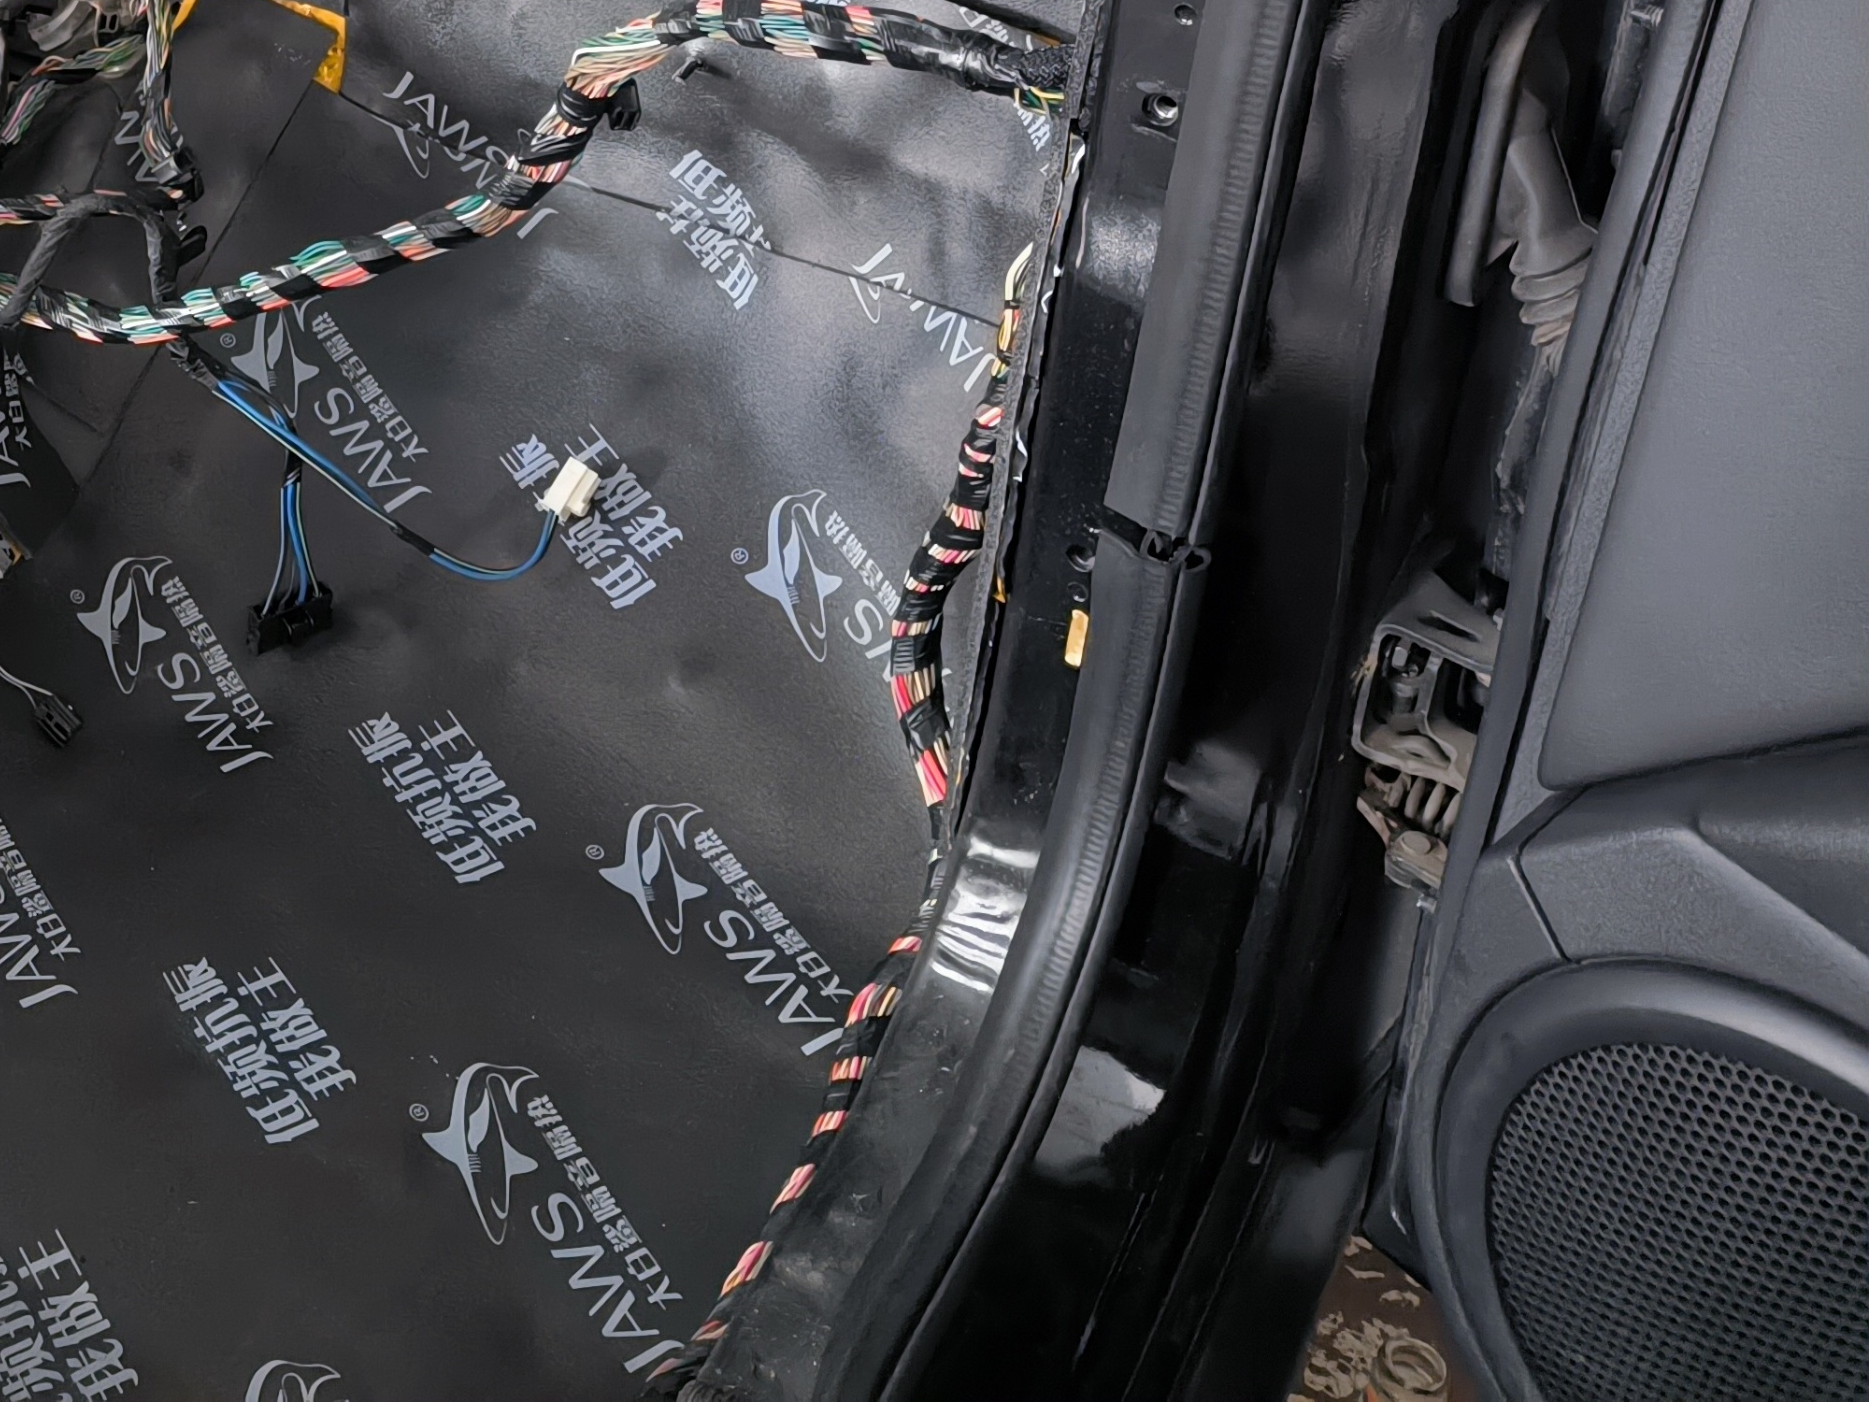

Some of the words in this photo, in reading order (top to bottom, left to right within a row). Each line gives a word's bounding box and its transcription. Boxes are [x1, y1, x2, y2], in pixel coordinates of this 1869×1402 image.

[315, 386, 431, 512] JAWS
[157, 651, 274, 774] JAWS
[348, 712, 505, 884] 低频抗振
[418, 709, 536, 844] 我做主
[693, 827, 853, 1002] 大白鲨隔音隔热
[704, 909, 842, 1056] JAWS
[162, 957, 319, 1144] 低频抗振
[238, 956, 356, 1100] 我做主
[527, 1094, 682, 1309] 大白鲨隔音隔热
[531, 1192, 685, 1373] JAWS
[18, 1228, 138, 1402] 我做主
